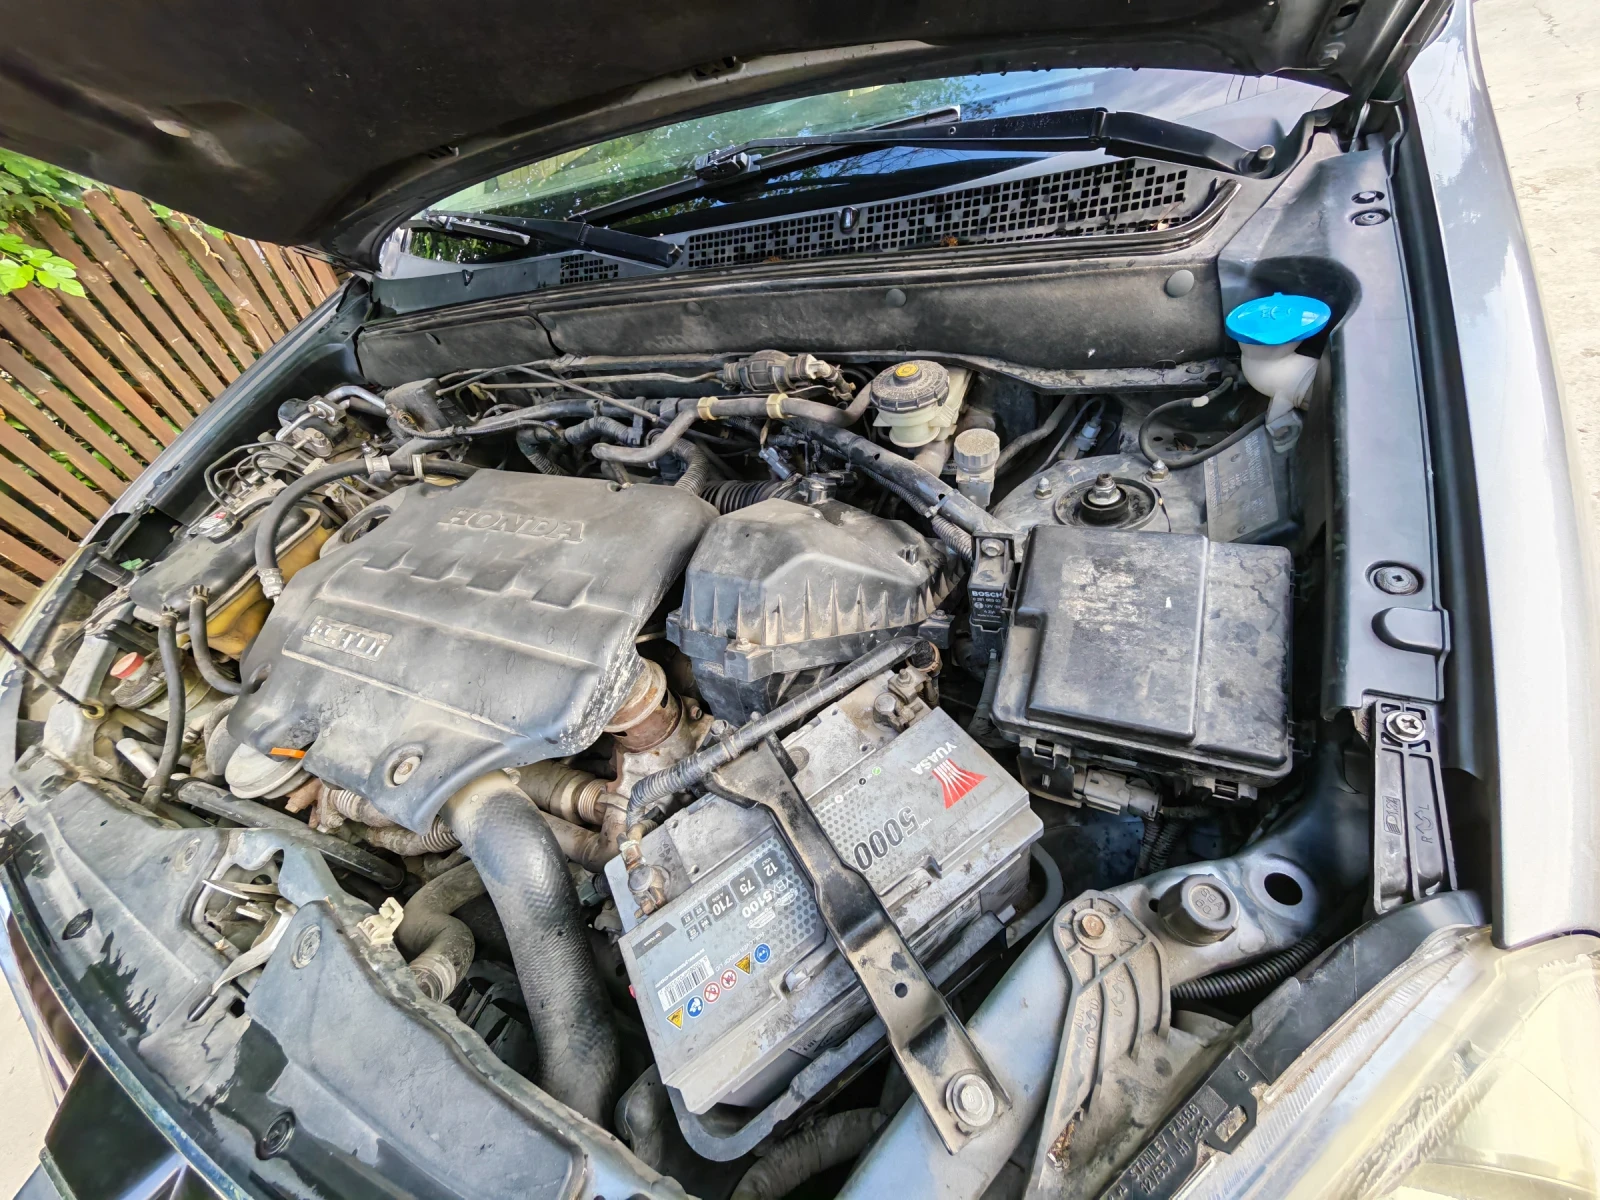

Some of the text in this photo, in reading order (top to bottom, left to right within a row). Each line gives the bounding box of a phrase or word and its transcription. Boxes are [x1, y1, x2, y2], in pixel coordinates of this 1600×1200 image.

[438, 506, 584, 543] HONDA
[910, 742, 958, 775] YUASA
[854, 806, 921, 870] 5000
[1421, 836, 1432, 844] R
[763, 862, 778, 876] 12
[740, 879, 756, 896] 75
[742, 877, 794, 918] YBX5100
[712, 896, 734, 916] 710
[654, 948, 705, 988] www.yuasa.com
[716, 964, 724, 972] LID
[724, 952, 740, 966] PROOF
[1129, 1134, 1170, 1180] STANLEY
